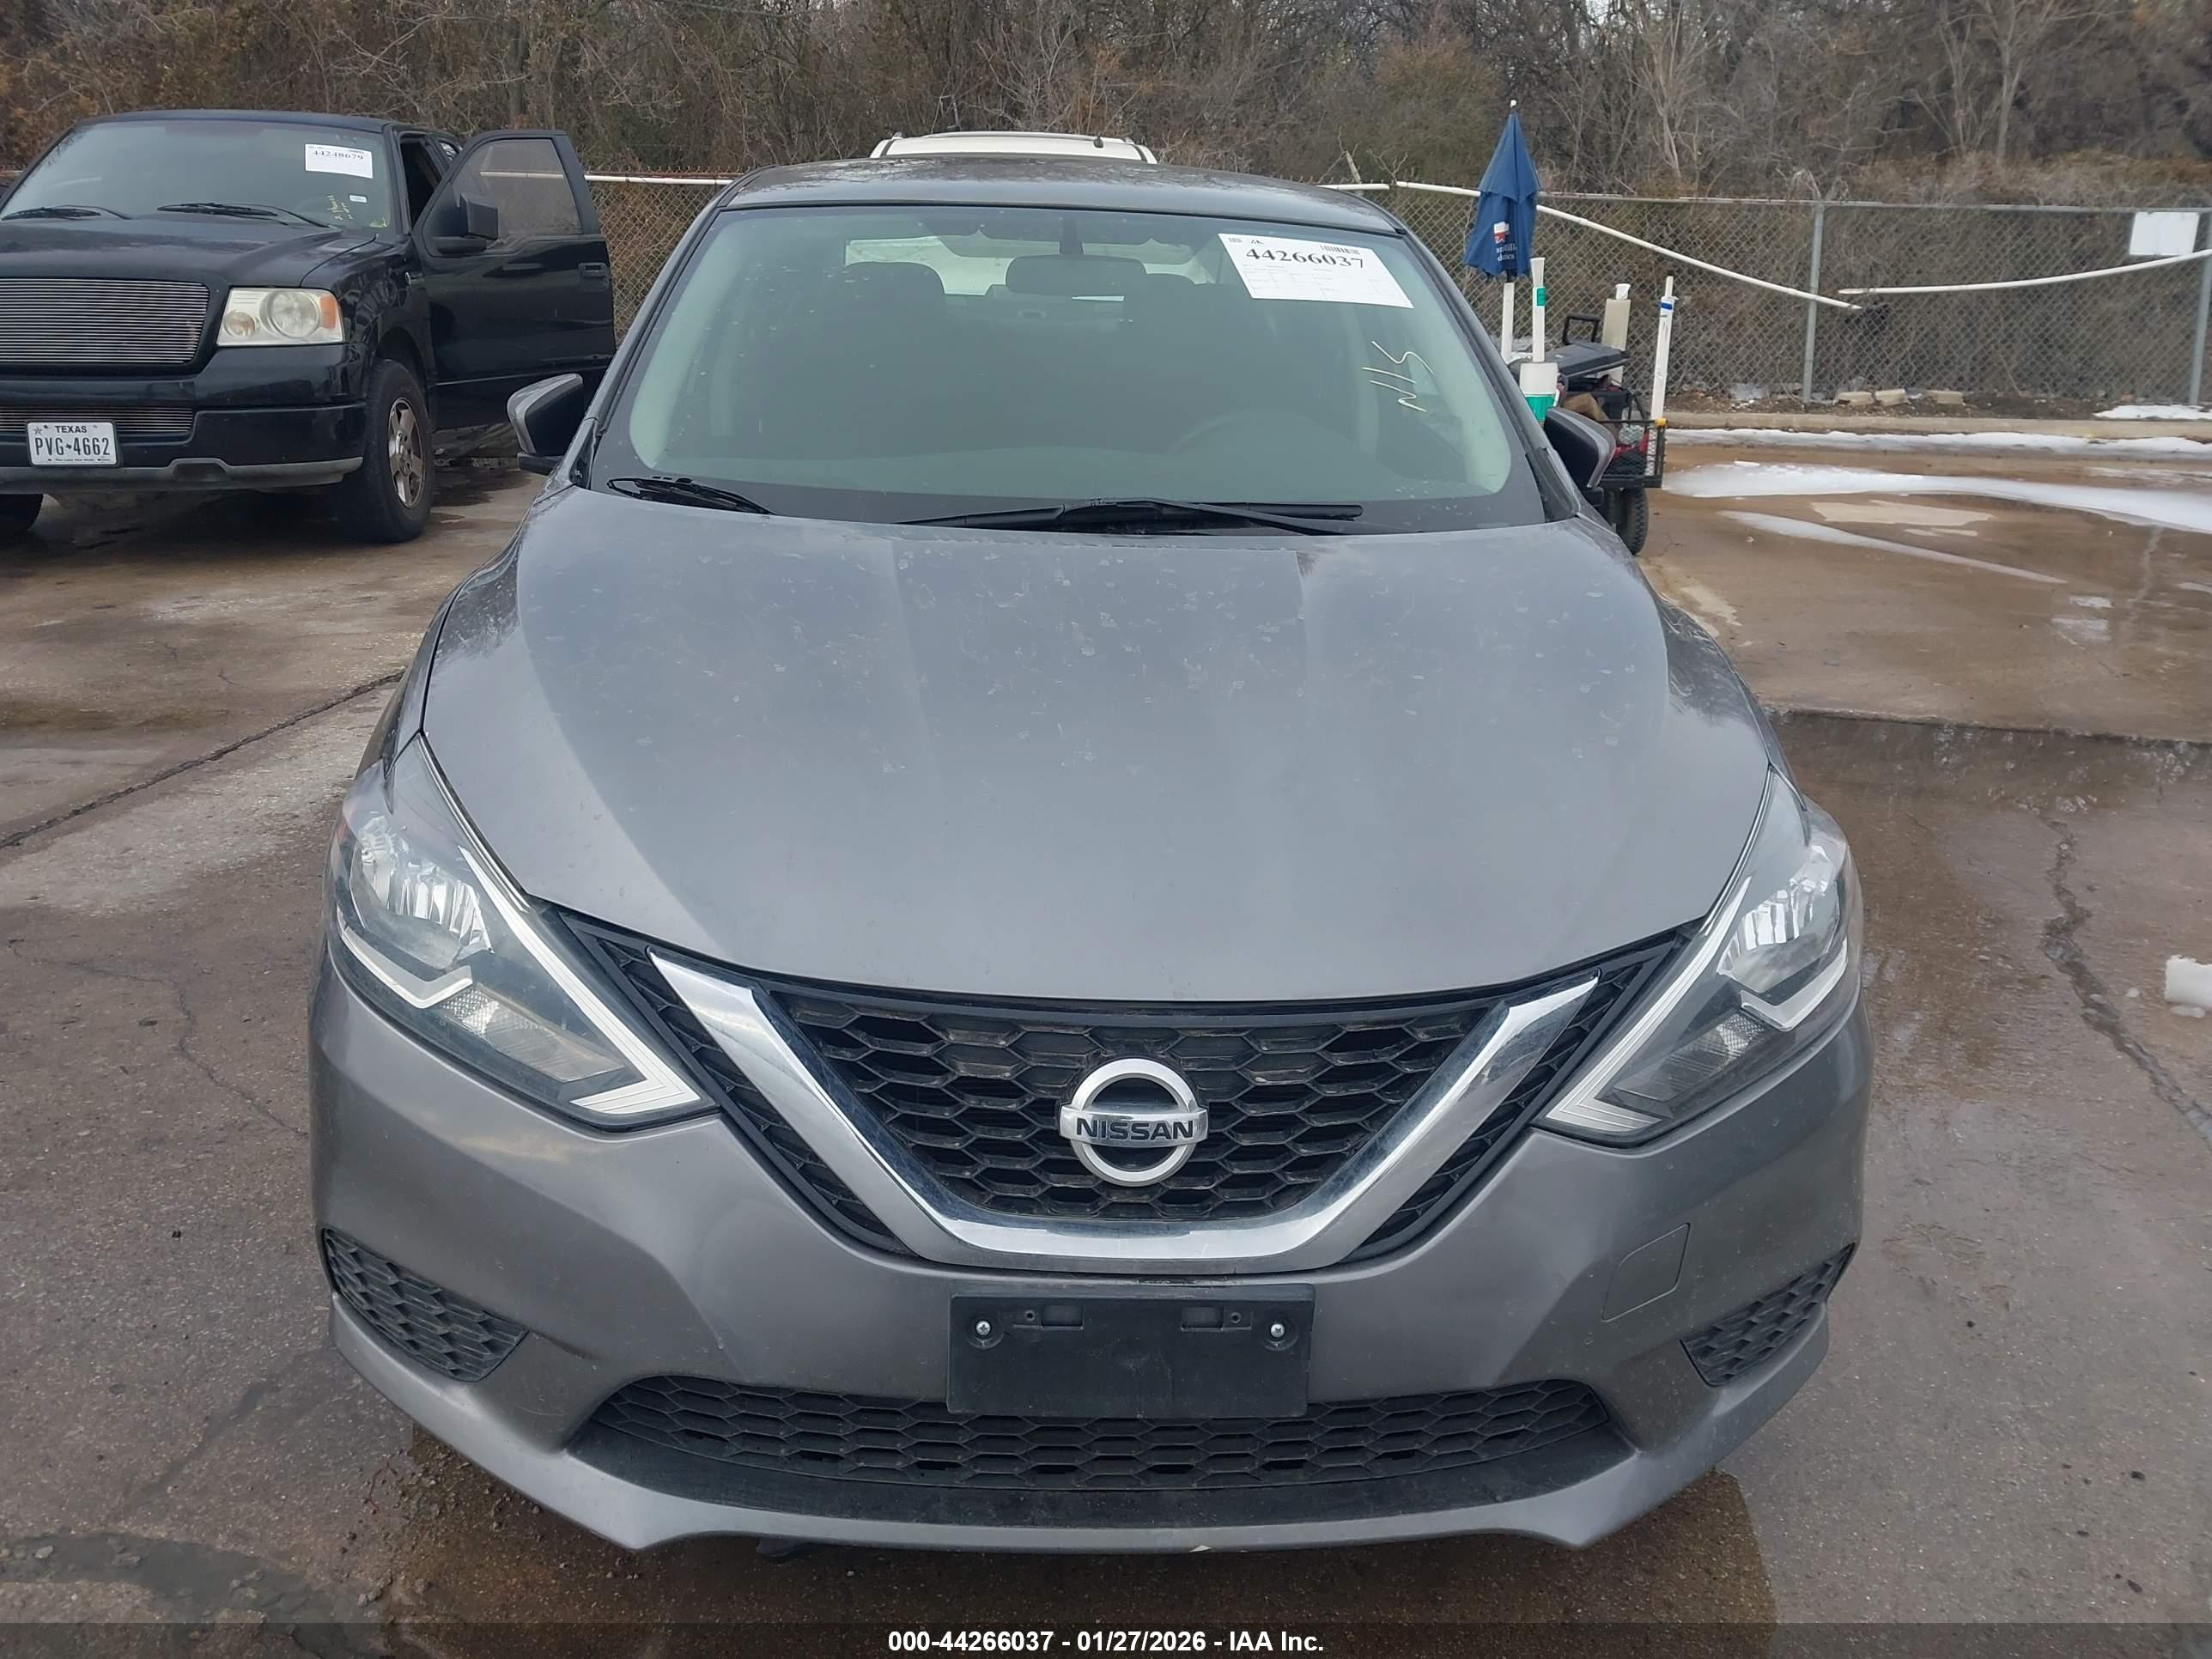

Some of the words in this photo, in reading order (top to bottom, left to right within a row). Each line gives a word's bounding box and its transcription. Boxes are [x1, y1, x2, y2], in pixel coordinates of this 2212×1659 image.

[1246, 247, 1364, 269] 44266037
[54, 425, 88, 434] TEXAS
[1076, 1117, 1194, 1140] NISSAN
